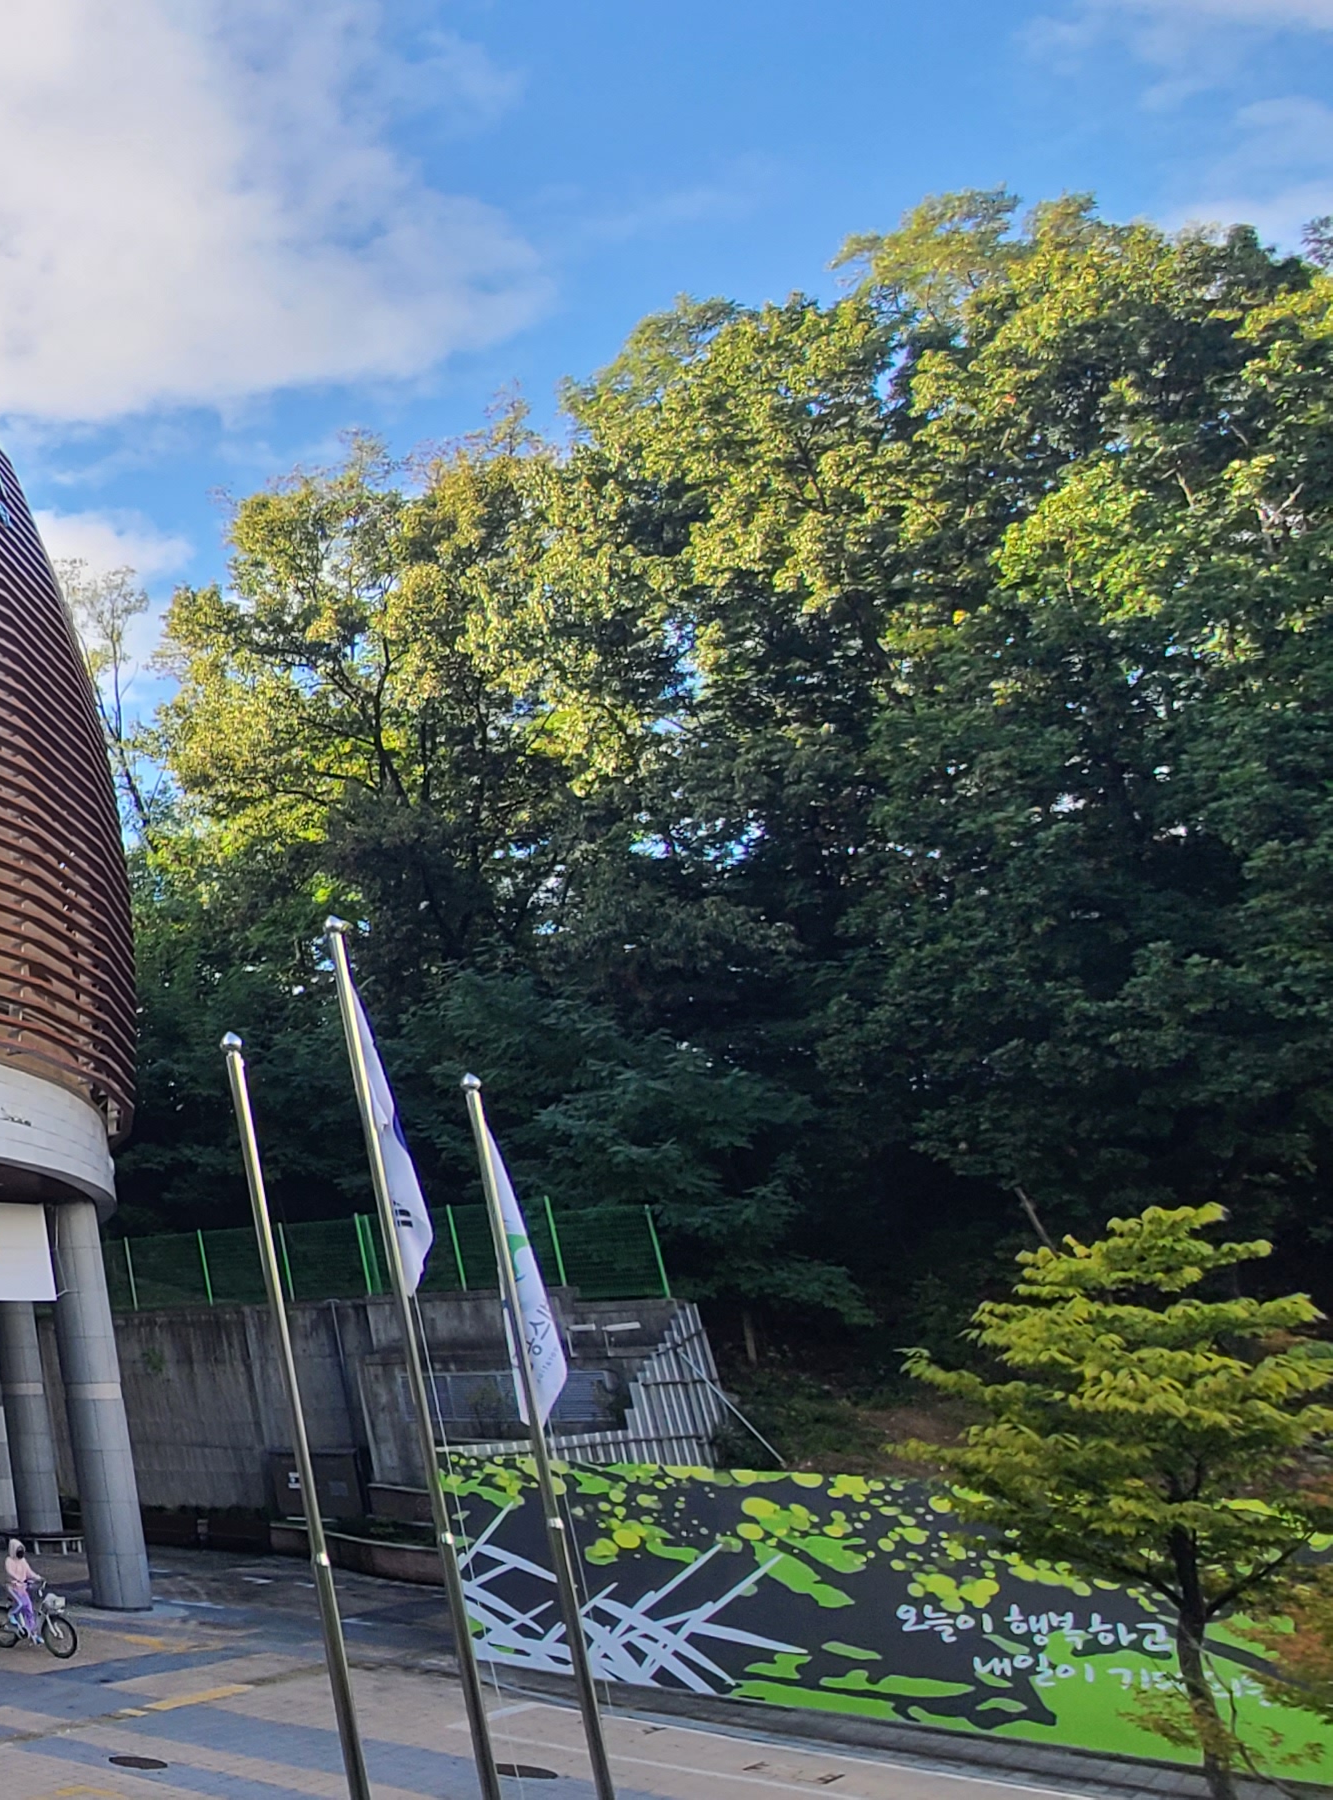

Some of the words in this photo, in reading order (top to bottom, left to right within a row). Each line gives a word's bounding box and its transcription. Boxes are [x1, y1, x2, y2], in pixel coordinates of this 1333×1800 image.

[896, 1603, 993, 1643] 오늘이
[1004, 1603, 1172, 1652] 행복하고
[973, 1653, 1095, 1688] 내일이
